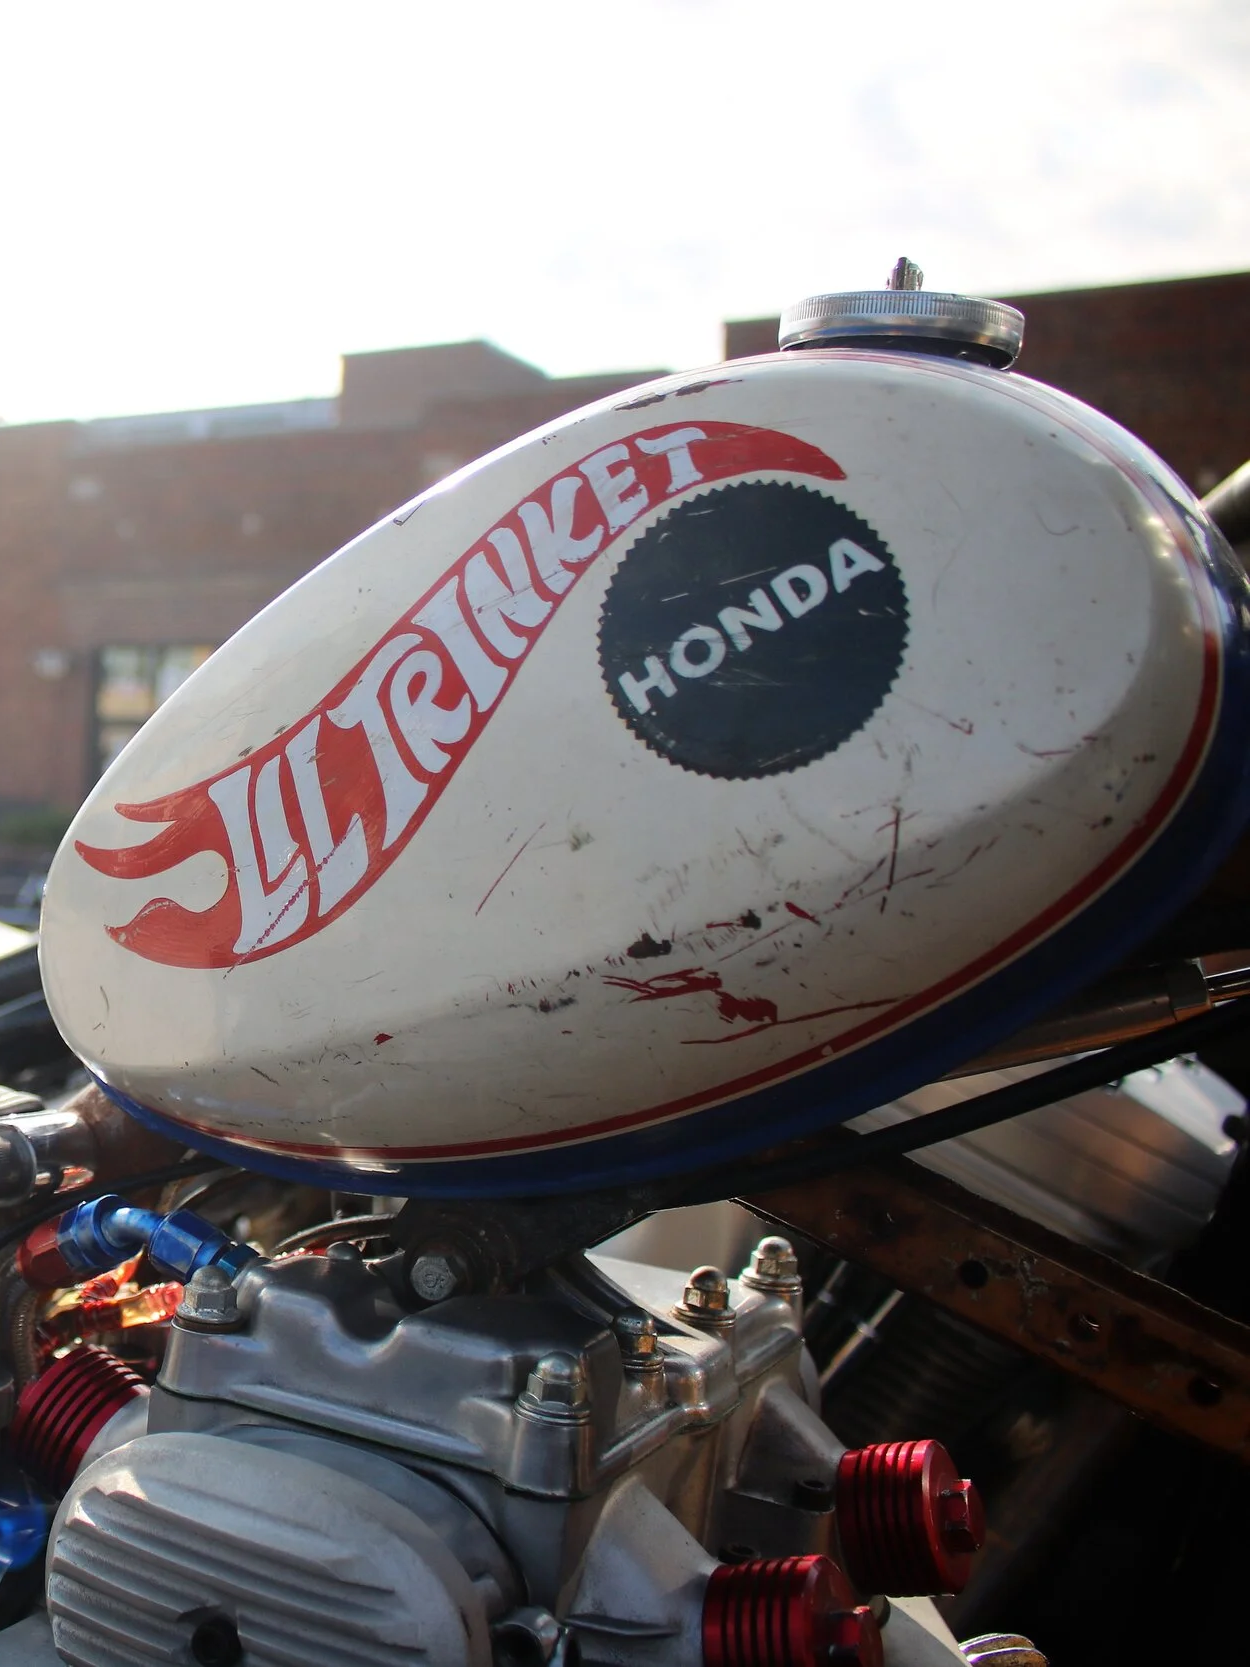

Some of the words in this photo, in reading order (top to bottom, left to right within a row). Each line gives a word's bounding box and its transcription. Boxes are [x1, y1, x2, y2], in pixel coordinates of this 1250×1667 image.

[207, 713, 369, 955] LIL
[325, 426, 707, 851] TRINKET
[617, 537, 886, 715] HONDA
